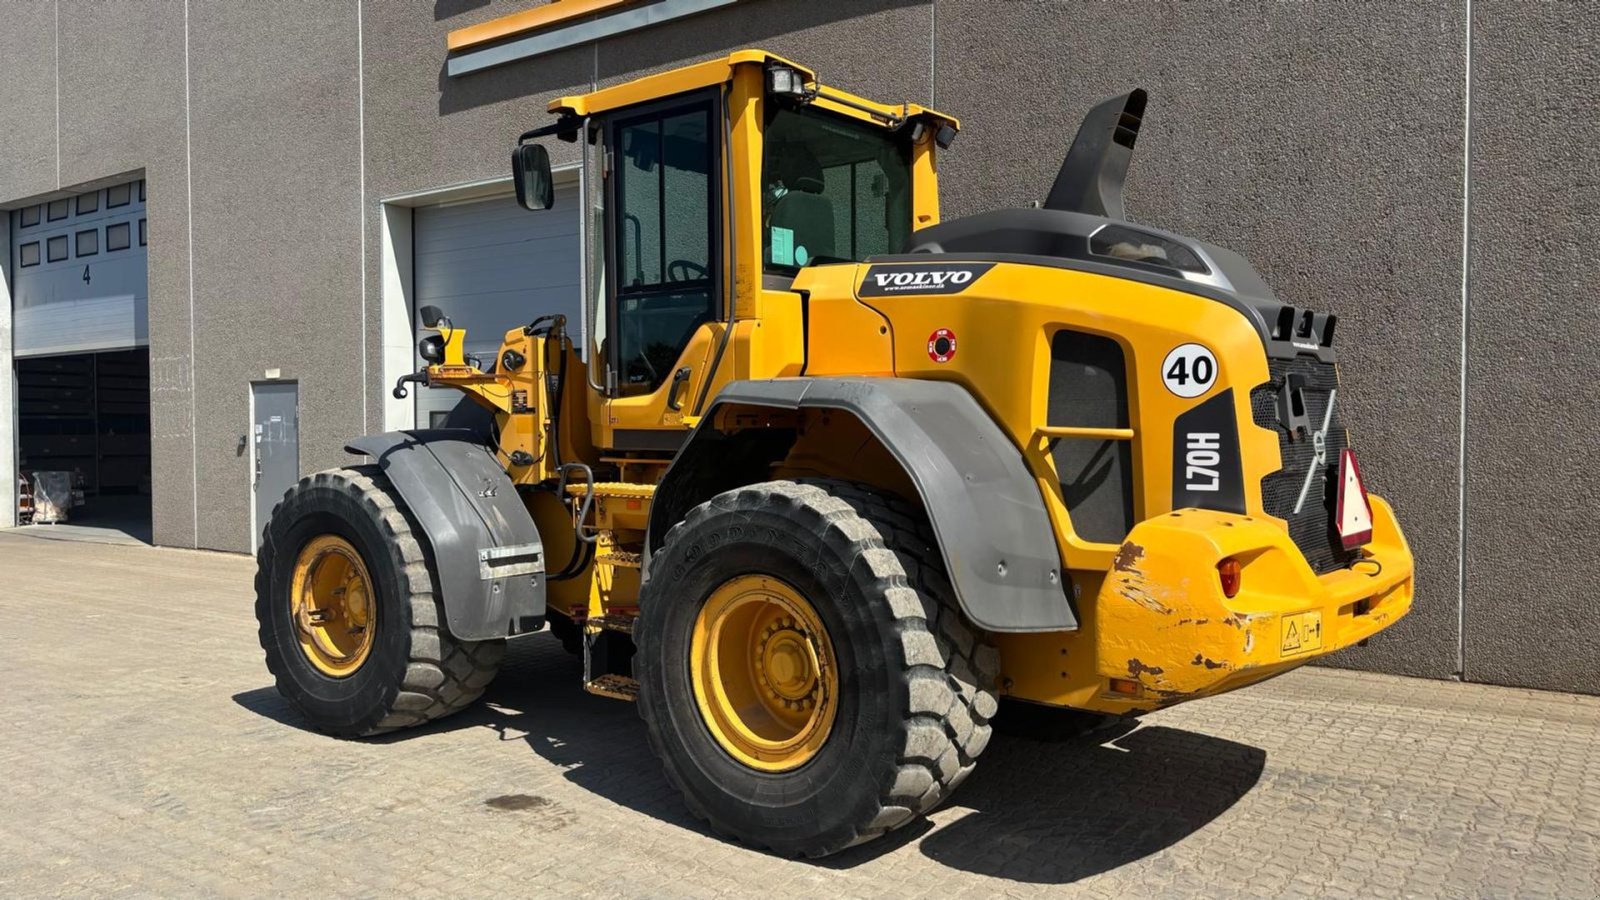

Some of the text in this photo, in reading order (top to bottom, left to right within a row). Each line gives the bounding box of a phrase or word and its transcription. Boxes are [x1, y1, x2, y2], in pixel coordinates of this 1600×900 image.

[83, 263, 91, 285] 4
[874, 270, 972, 287] VOLVO
[1166, 355, 1213, 385] 40
[1185, 432, 1220, 491] L70H
